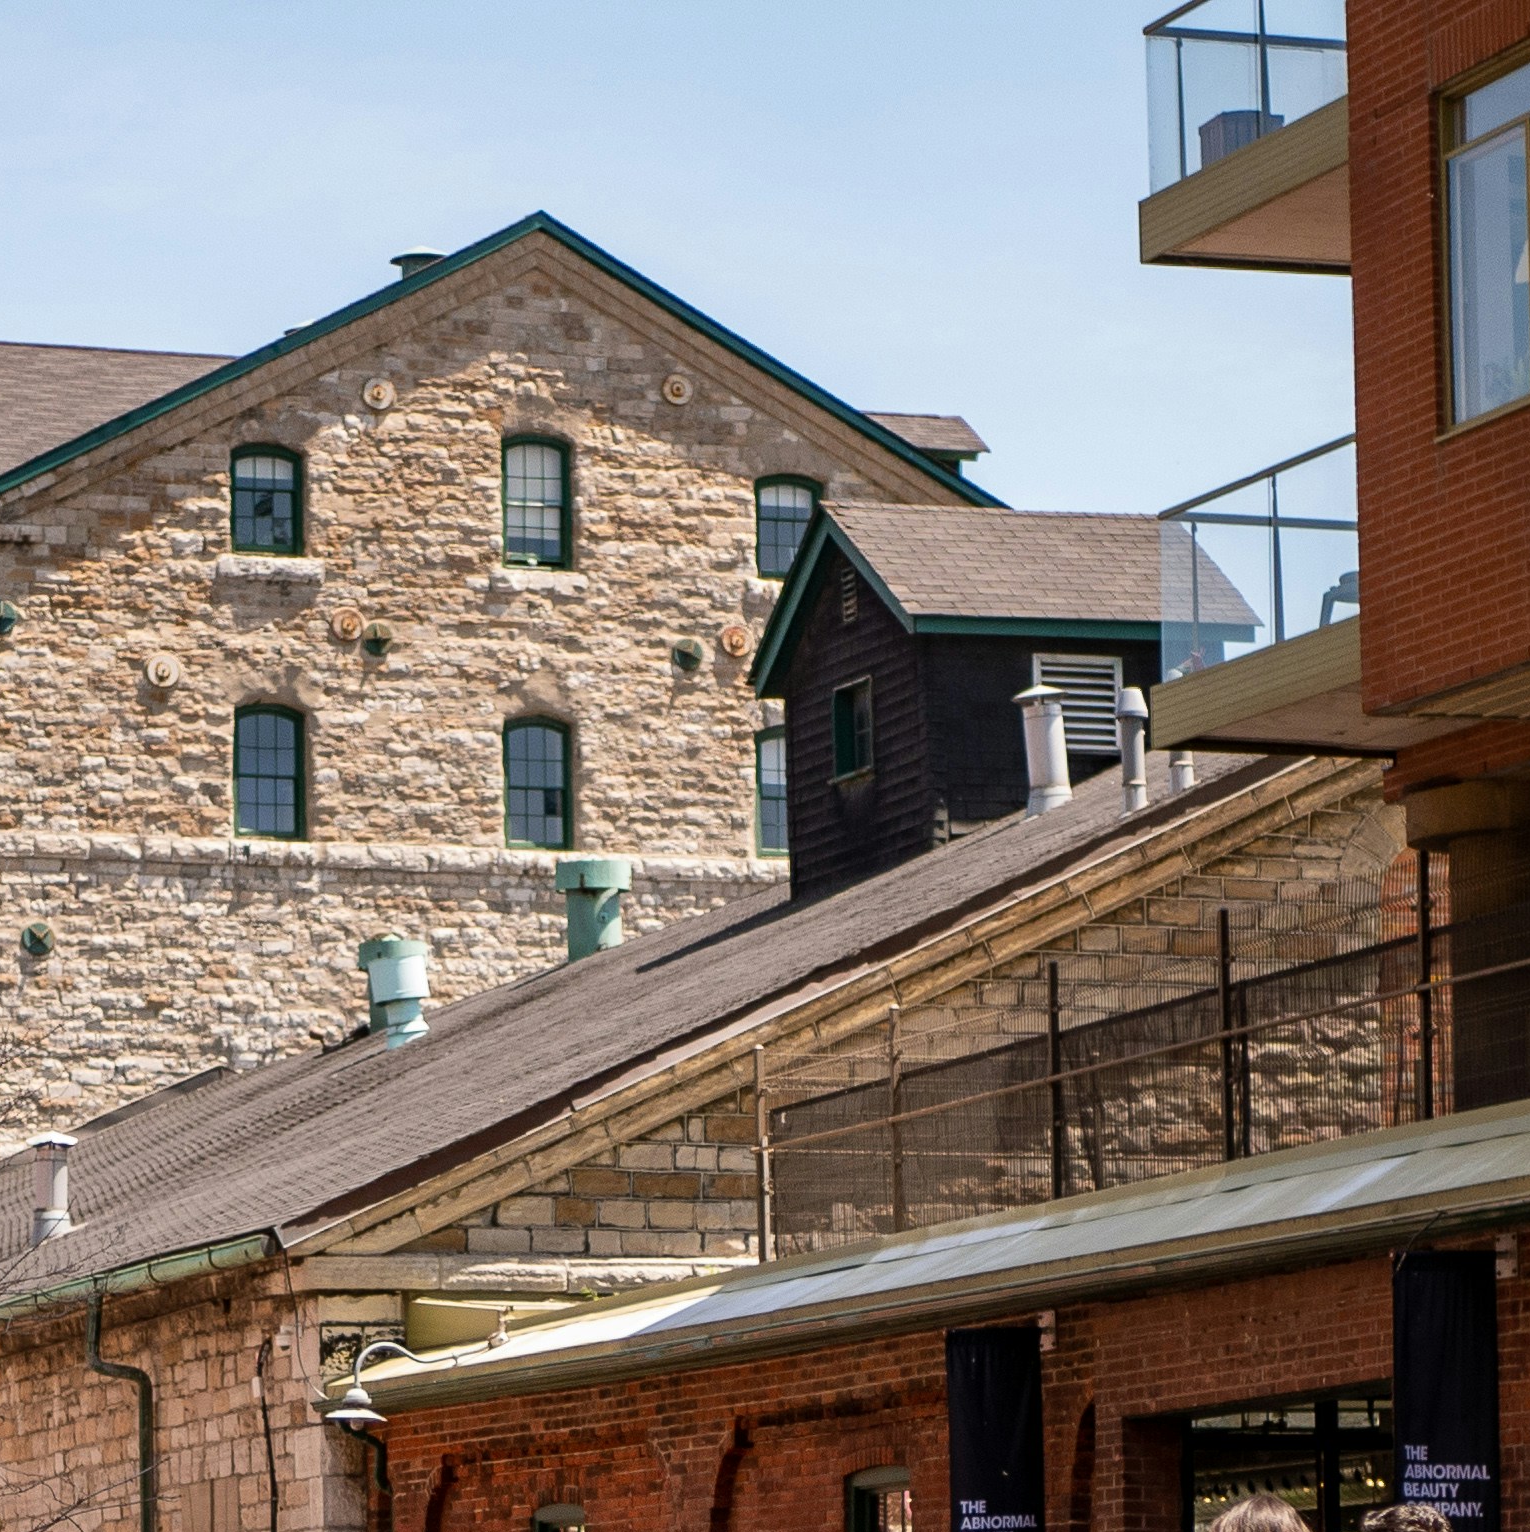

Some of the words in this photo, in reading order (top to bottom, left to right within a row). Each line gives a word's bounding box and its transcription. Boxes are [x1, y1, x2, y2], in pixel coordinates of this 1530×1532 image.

[1404, 1445, 1428, 1461] THE
[1404, 1464, 1490, 1479] ABNORMAL
[1403, 1482, 1459, 1498] BEAUTY
[960, 1500, 986, 1514] THE
[1407, 1500, 1483, 1517] PANY.
[960, 1515, 1037, 1530] ABNORMAL
